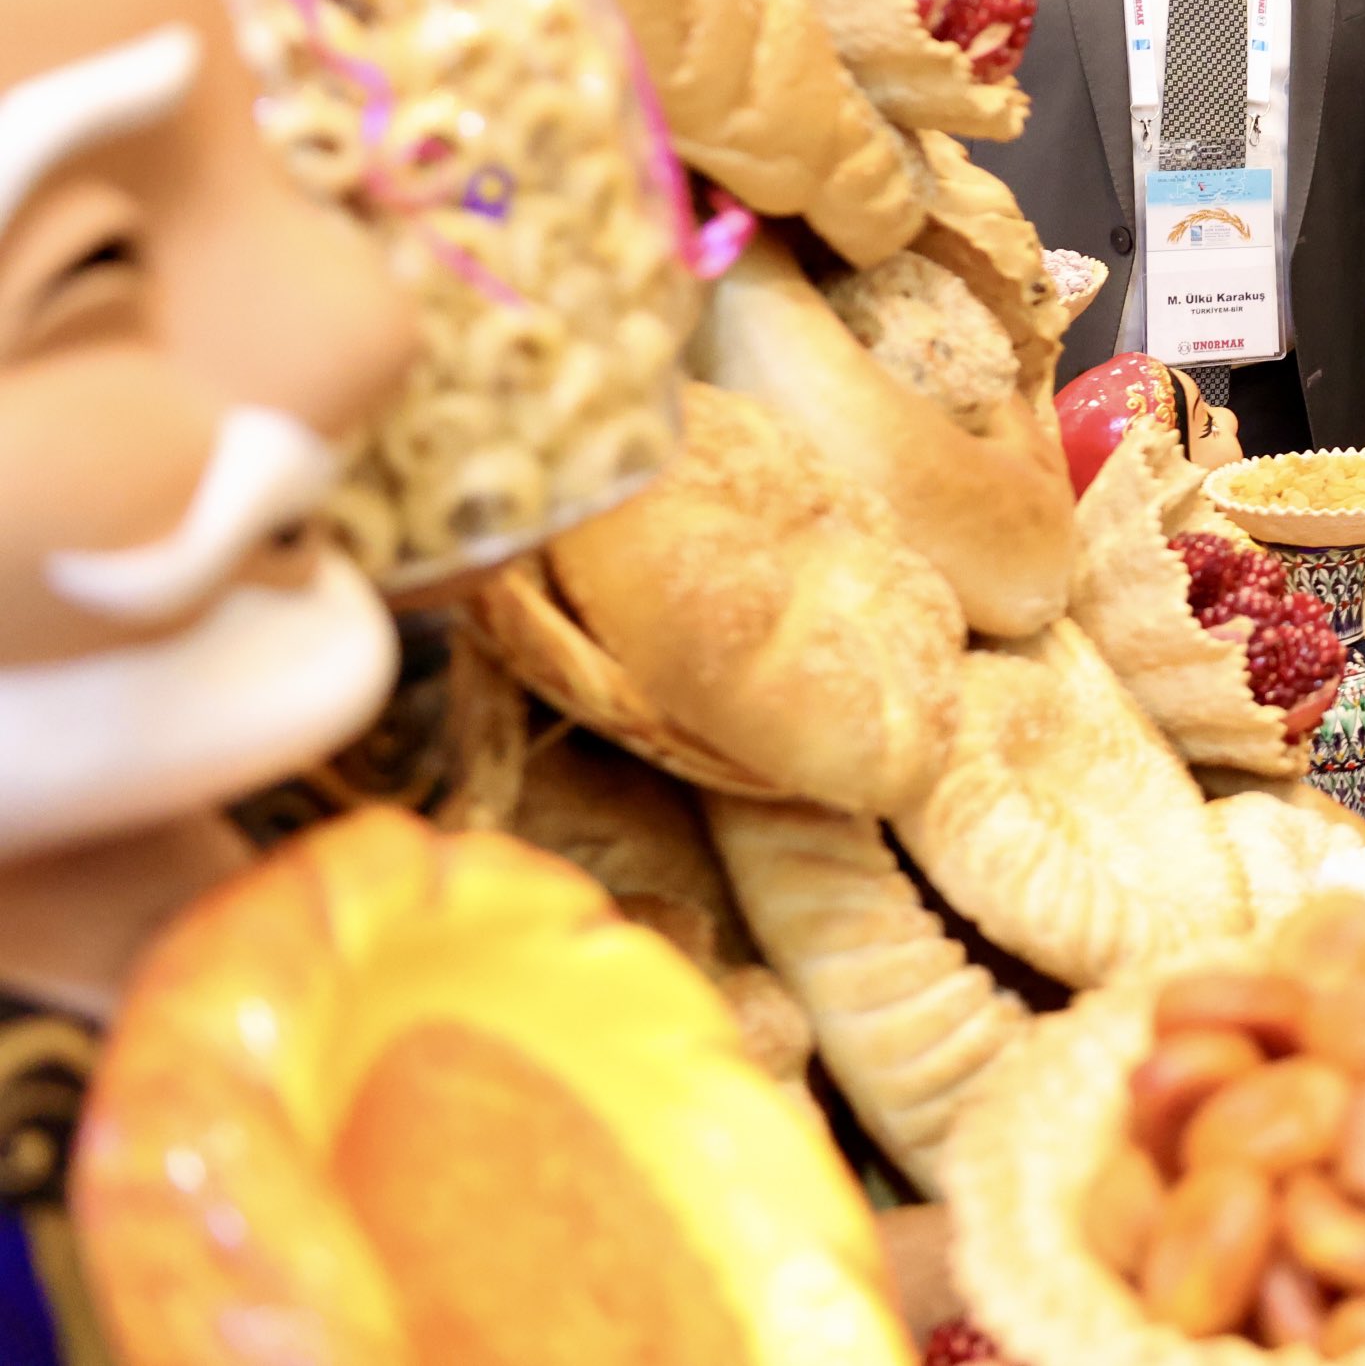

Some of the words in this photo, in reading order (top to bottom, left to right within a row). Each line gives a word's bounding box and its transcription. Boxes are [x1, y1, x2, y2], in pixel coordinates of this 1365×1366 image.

[1167, 295, 1181, 305] M.
[1185, 292, 1213, 304] Ülkü
[1217, 291, 1266, 303] Karakuş
[1192, 338, 1245, 351] UNORMAK
